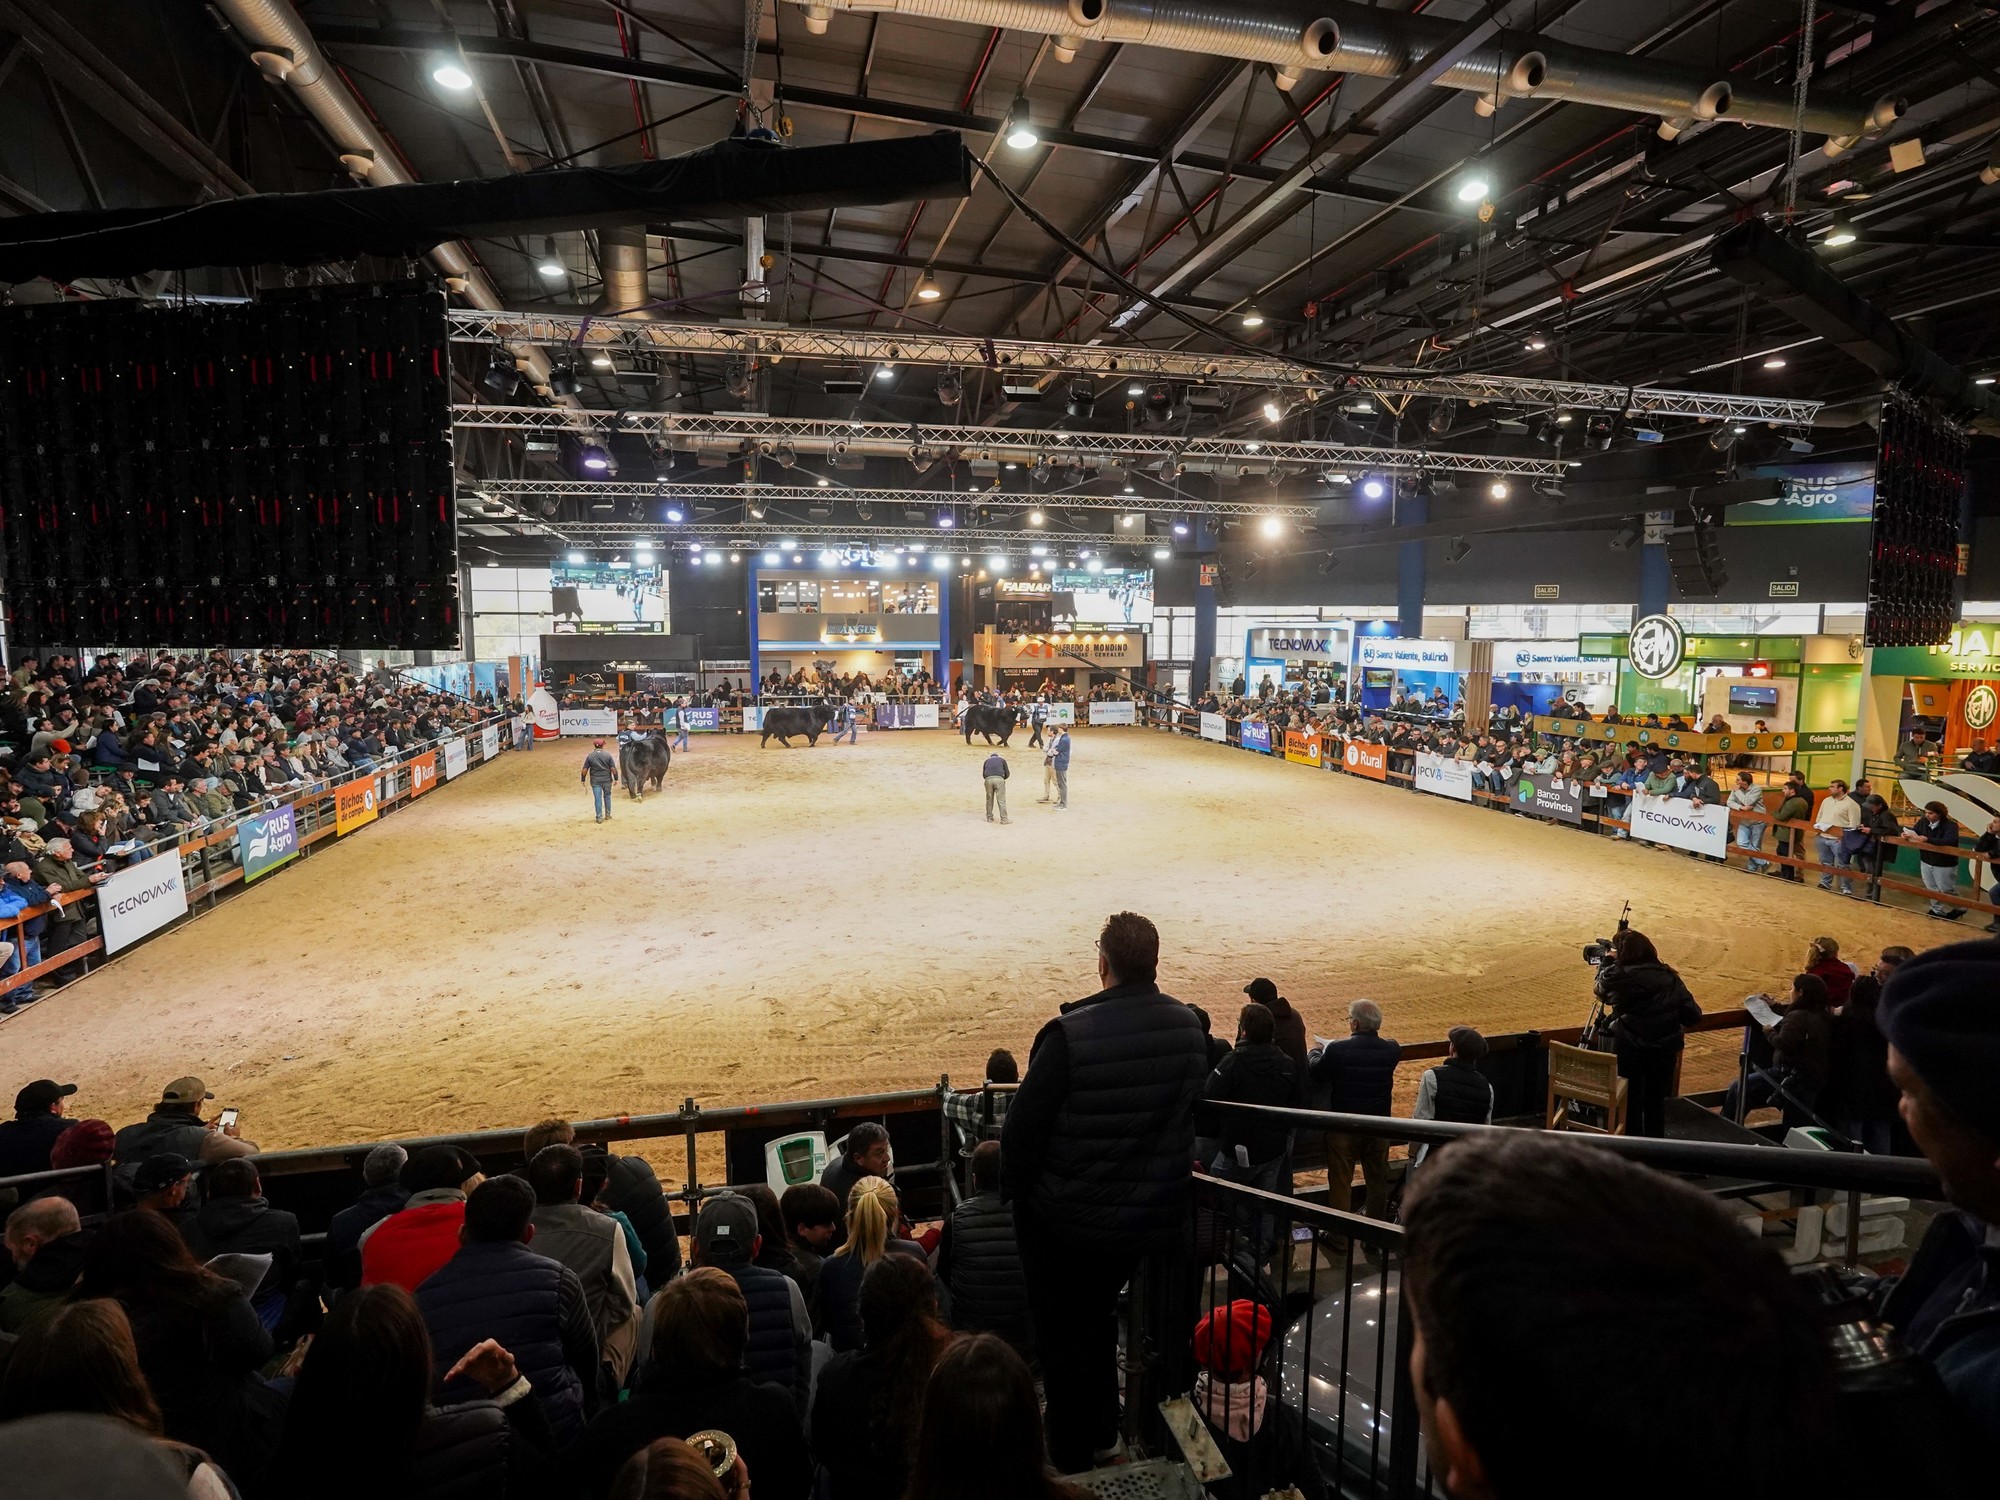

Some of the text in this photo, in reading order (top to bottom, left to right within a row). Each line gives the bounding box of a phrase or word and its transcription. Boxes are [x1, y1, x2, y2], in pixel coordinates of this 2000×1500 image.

[1792, 477, 1838, 491] RUS
[1784, 492, 1837, 507] Agro
[1002, 582, 1052, 592] FAENAR
[839, 625, 878, 634] ANGUS
[1055, 643, 1084, 652] ALFREDO
[1093, 643, 1128, 652] MONDINO
[1268, 638, 1325, 652] TECNOVAX
[1376, 649, 1393, 659] Saenz
[1421, 651, 1448, 662] Bullrich
[1532, 654, 1552, 662] Saenz
[692, 710, 712, 719] RUS
[690, 719, 713, 727] Agro
[1252, 727, 1266, 740] RUS
[1288, 738, 1309, 750] Bichos
[1294, 749, 1308, 758] campo
[1360, 750, 1382, 769] Rural
[422, 760, 436, 782] Rural
[1536, 788, 1561, 801] Banco
[340, 792, 364, 812] Bichos
[1536, 798, 1573, 814] Provincia
[341, 805, 365, 822] de campo
[268, 813, 291, 836] RUS
[1638, 809, 1709, 835] TECNOVAX
[268, 831, 292, 854] Agro
[109, 880, 173, 919] TECNOVAX
